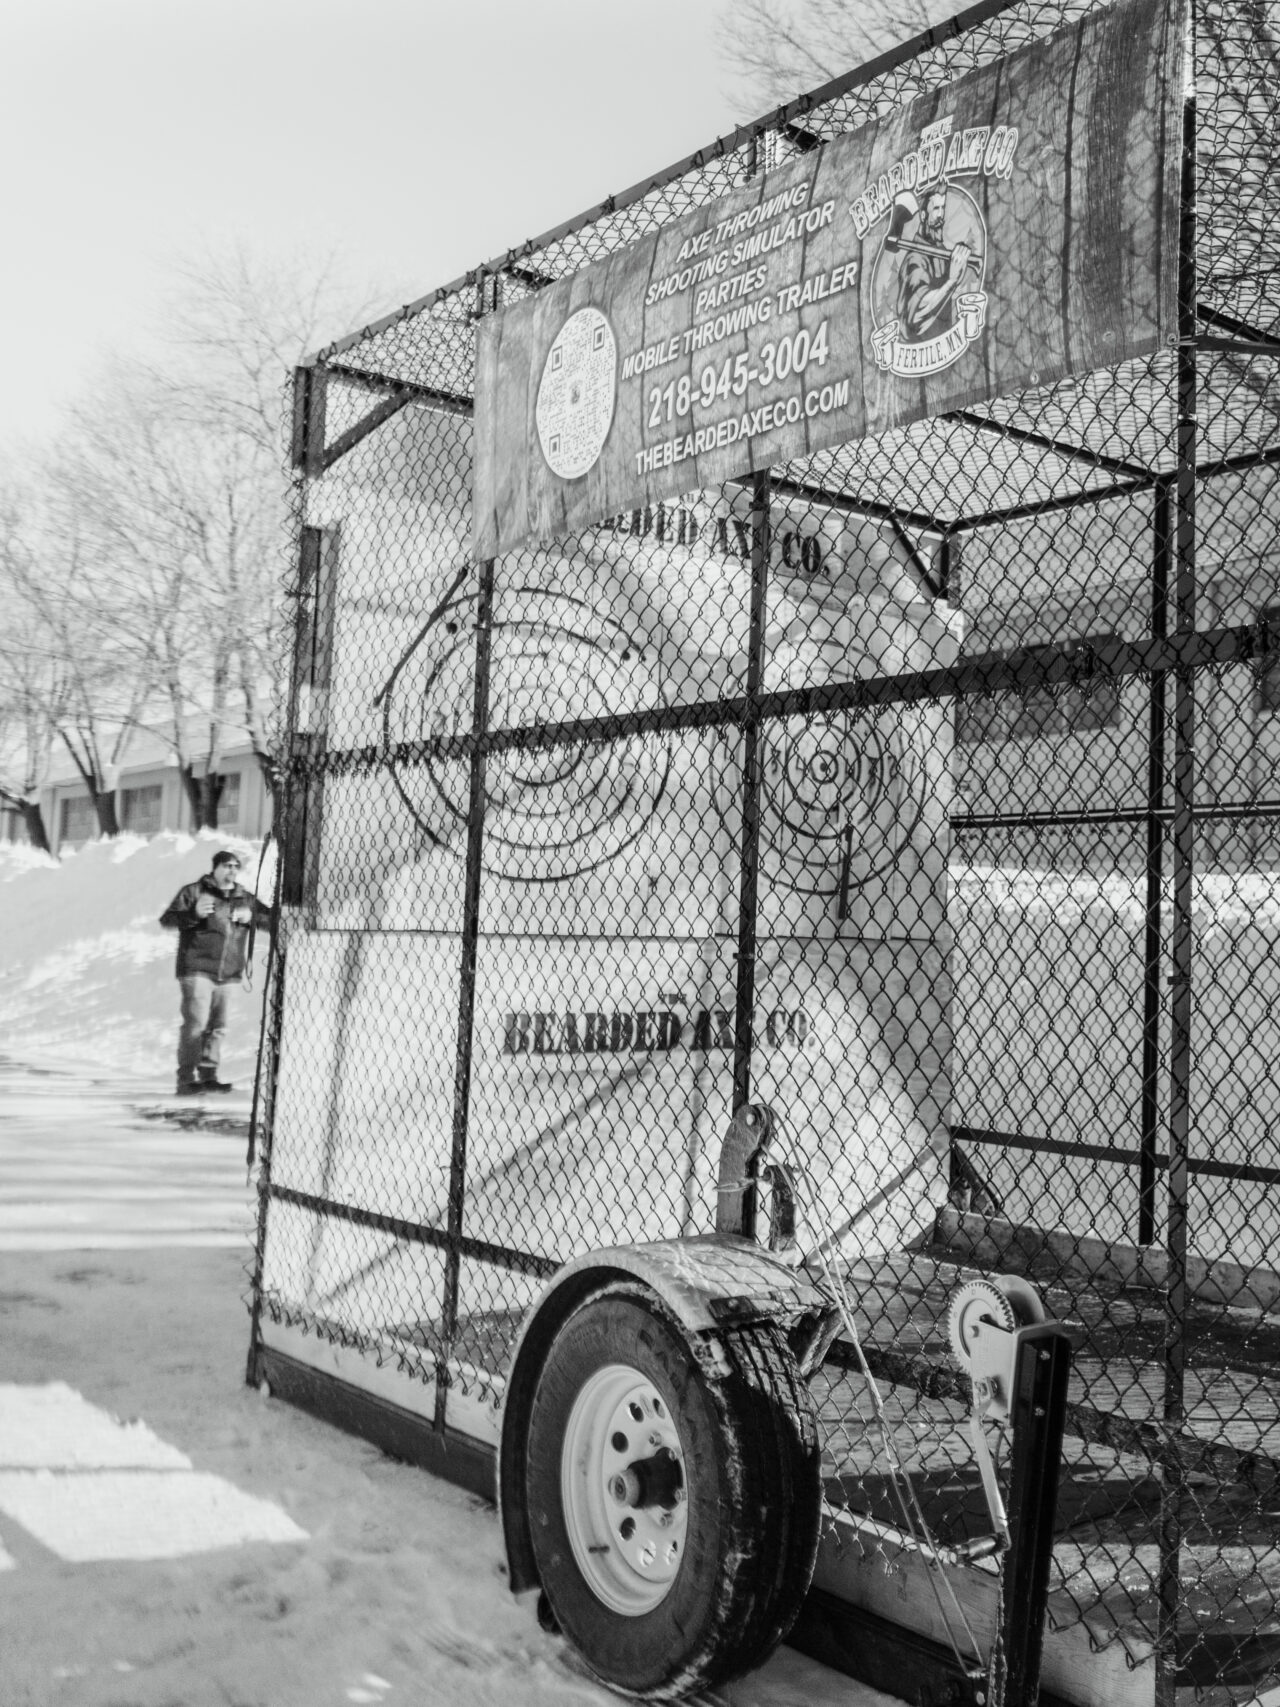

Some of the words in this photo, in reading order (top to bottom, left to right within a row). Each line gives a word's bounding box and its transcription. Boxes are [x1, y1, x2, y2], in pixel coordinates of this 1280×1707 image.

[676, 229, 713, 263] AXE
[714, 182, 809, 245] THROWING
[849, 139, 945, 239] BEARDED
[944, 126, 991, 178] AXE
[645, 250, 729, 306] SHOOTING
[731, 200, 835, 266] SIMULATOR
[695, 264, 768, 315] PARTIES
[621, 336, 680, 380] MOBILE
[683, 296, 772, 354] THROWING
[777, 262, 858, 315] TRAILER
[946, 327, 964, 356] MN
[648, 320, 830, 428] 218-945-3004
[635, 379, 850, 475] THEBEARDEDAXECO.COM
[502, 1011, 681, 1055] BEARDED
[689, 1010, 757, 1051] AX
